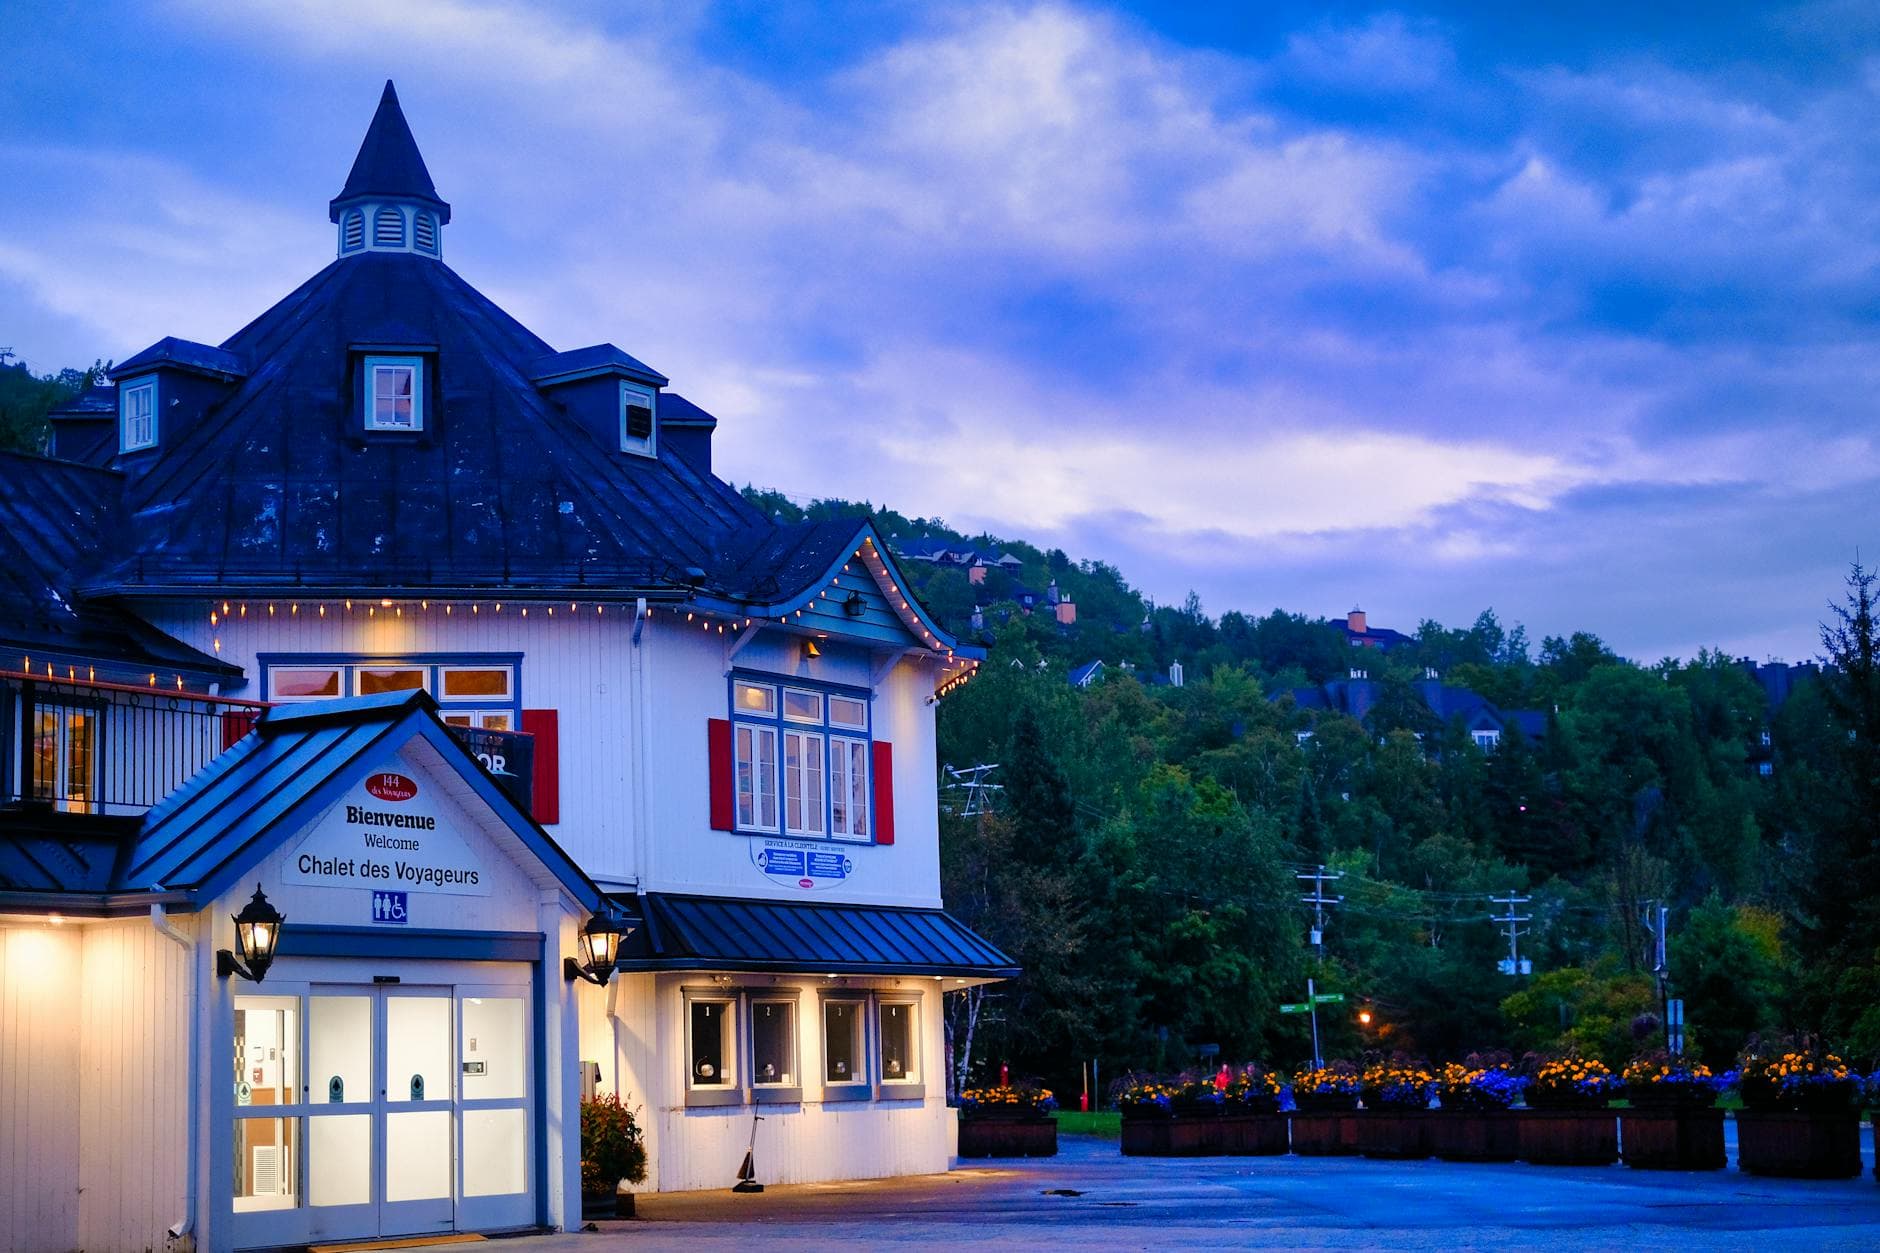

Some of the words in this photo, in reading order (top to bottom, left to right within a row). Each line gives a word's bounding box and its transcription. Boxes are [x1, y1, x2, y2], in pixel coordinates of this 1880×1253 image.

[472, 751, 505, 771] OR
[383, 775, 399, 787] 144
[372, 786, 382, 795] des
[383, 787, 411, 798] Voyageurs
[346, 805, 435, 831] Bienvenue
[364, 833, 420, 850] Welcome
[298, 854, 355, 877] Chalet
[360, 859, 390, 879] des
[395, 861, 479, 887] Voyageurs
[705, 1006, 710, 1017] 1
[766, 1006, 771, 1017] 2
